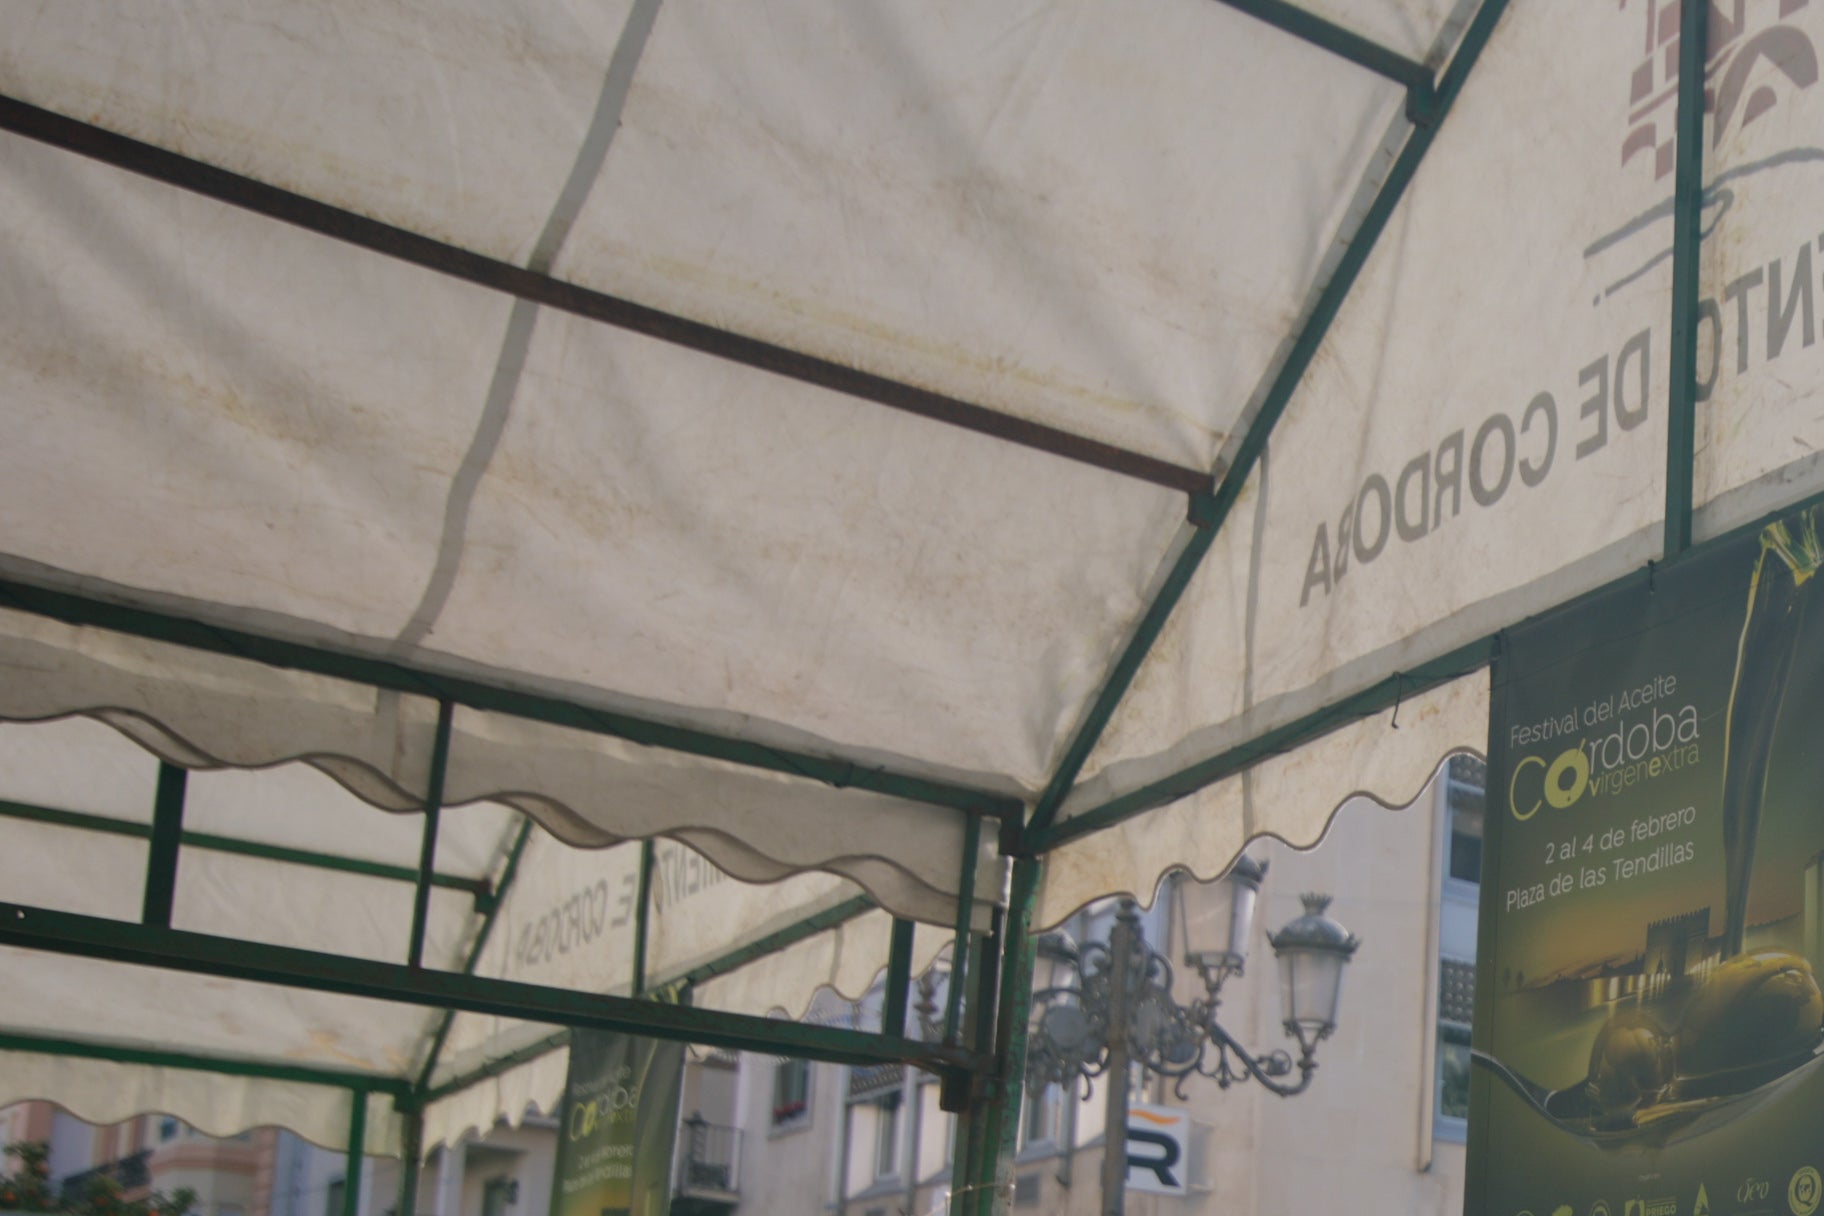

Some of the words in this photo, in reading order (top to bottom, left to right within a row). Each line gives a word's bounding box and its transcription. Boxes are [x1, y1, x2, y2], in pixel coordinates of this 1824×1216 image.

[1509, 707, 1580, 749] Festival
[1582, 701, 1614, 729] del
[1618, 674, 1678, 713] Aceite
[1545, 843, 1556, 865] 2
[1558, 837, 1576, 862] al
[1582, 834, 1594, 854] 4
[1599, 826, 1626, 852] de
[1630, 805, 1697, 845] febrero
[1506, 885, 1546, 913] Plaza
[1548, 871, 1575, 897] de
[1579, 862, 1607, 889] las
[1612, 838, 1696, 882] Tendillas
[1646, 1204, 1677, 1216] PRIEGO
